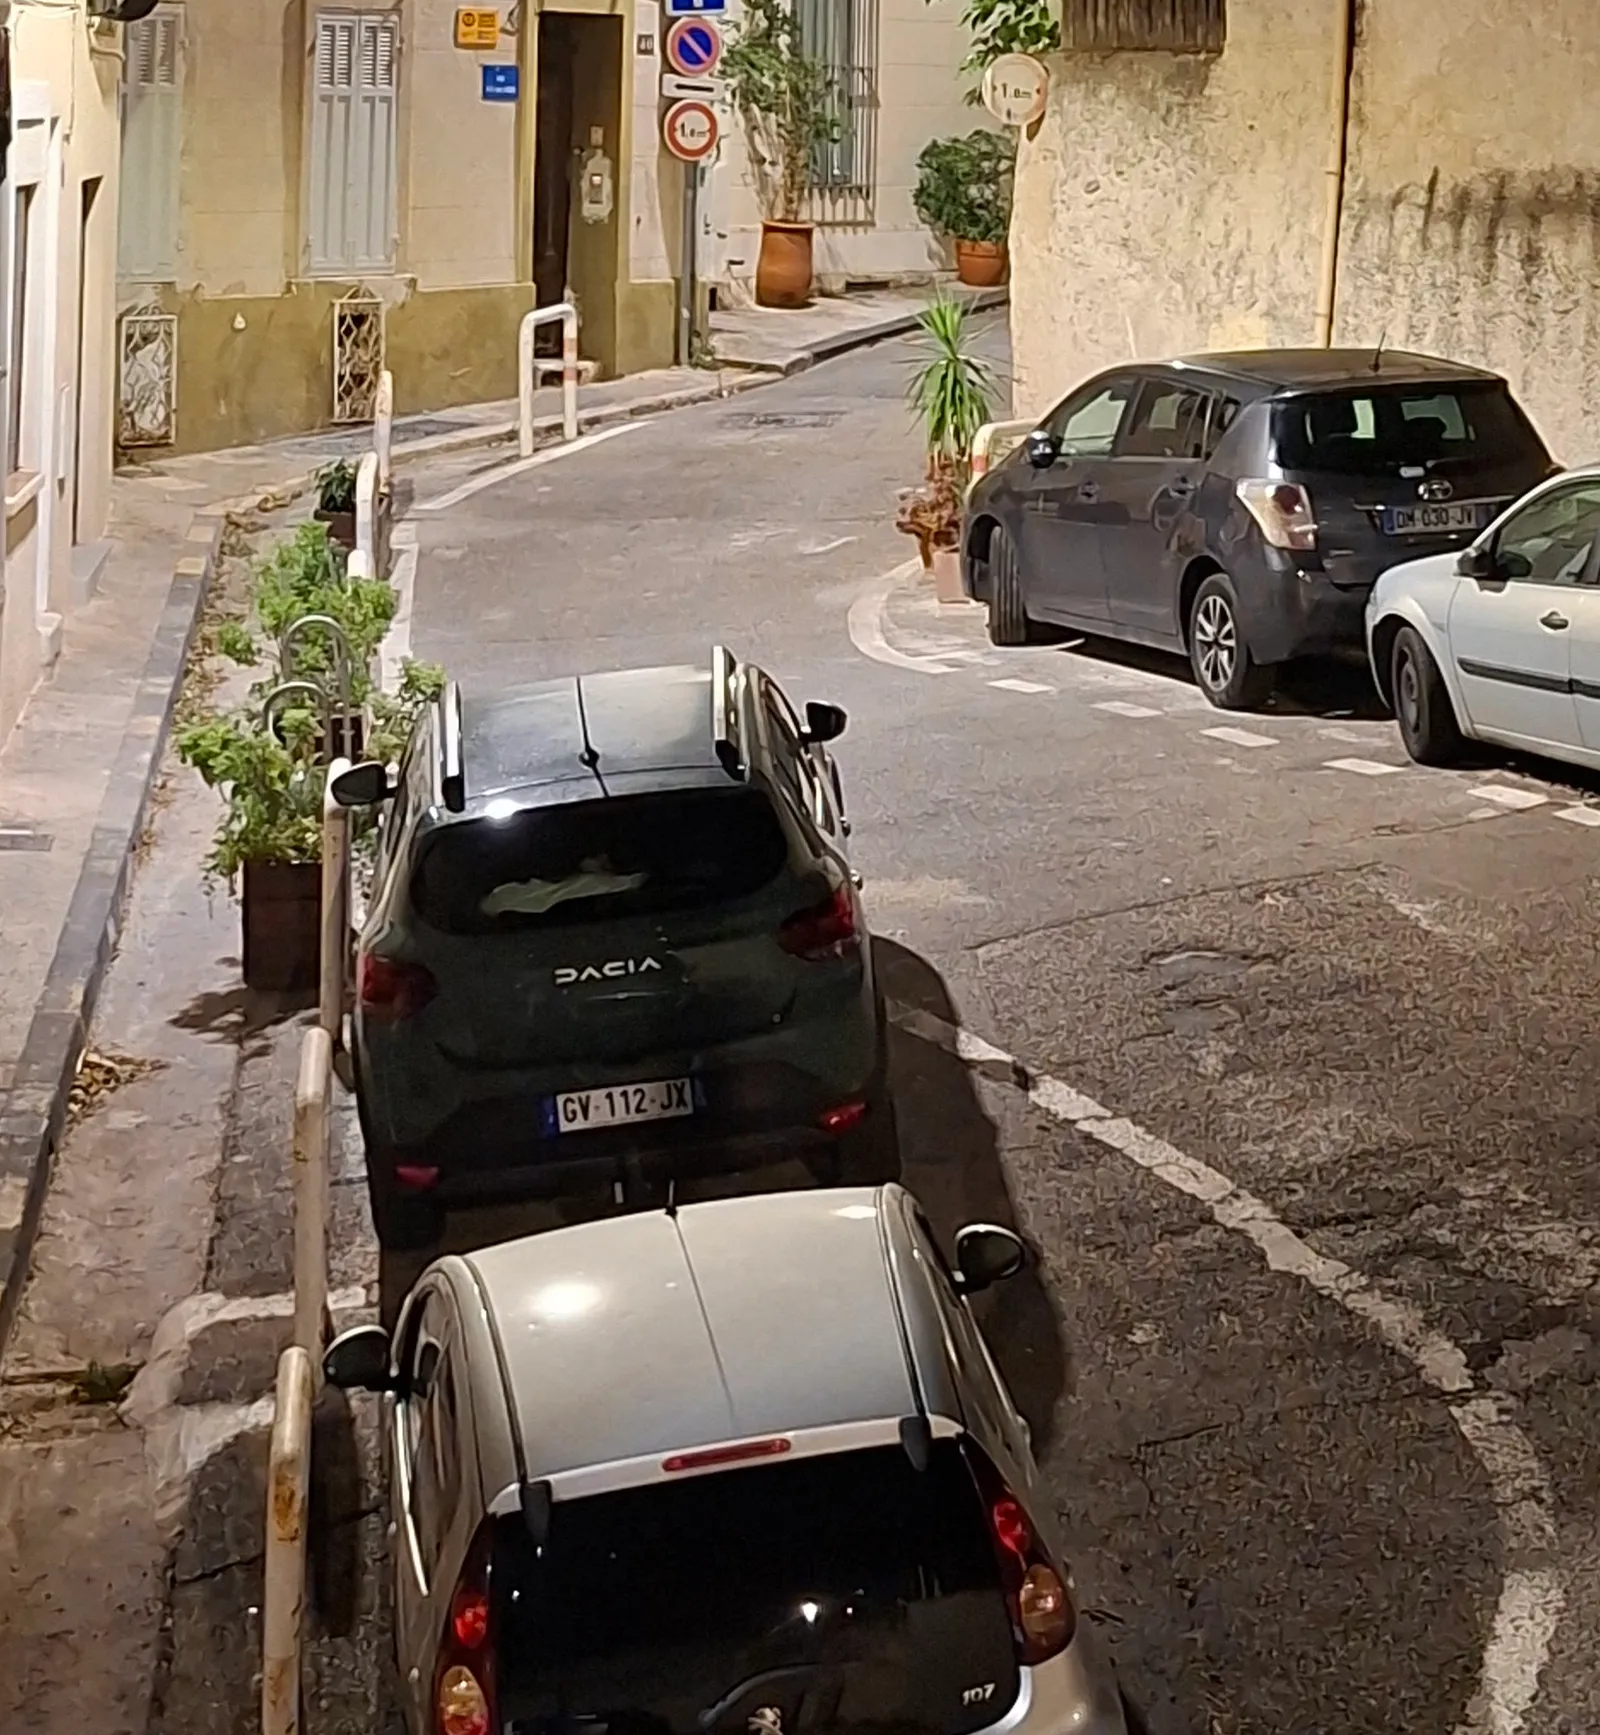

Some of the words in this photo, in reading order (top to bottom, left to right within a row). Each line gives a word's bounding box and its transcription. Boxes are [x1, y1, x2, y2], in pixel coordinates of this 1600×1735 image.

[554, 956, 662, 985] DACIA
[562, 1081, 689, 1124] GV-112-JX
[962, 1682, 996, 1706] 107
